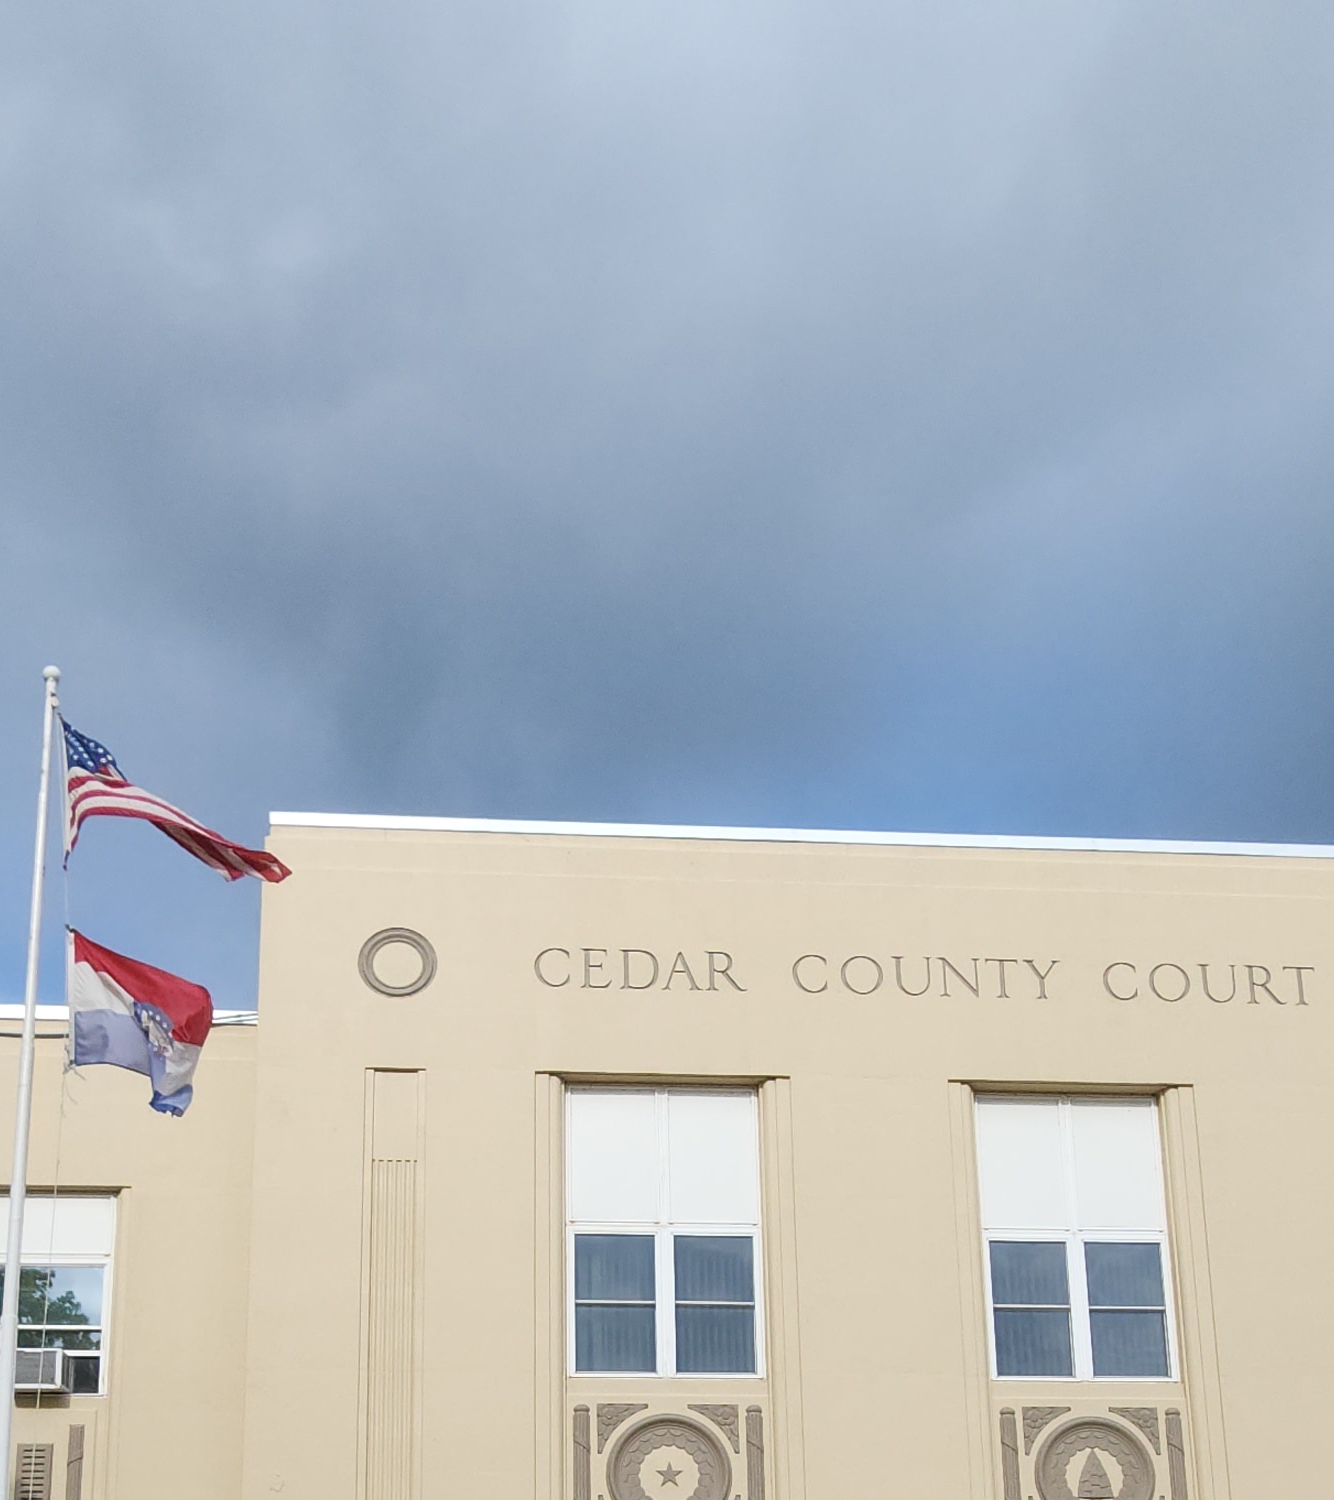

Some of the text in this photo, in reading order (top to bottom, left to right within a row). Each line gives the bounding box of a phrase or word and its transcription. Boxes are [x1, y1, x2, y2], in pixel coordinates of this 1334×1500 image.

[533, 947, 748, 993] CEDAR
[790, 953, 1061, 1001] COUNTY
[1101, 961, 1316, 1007] COURT
